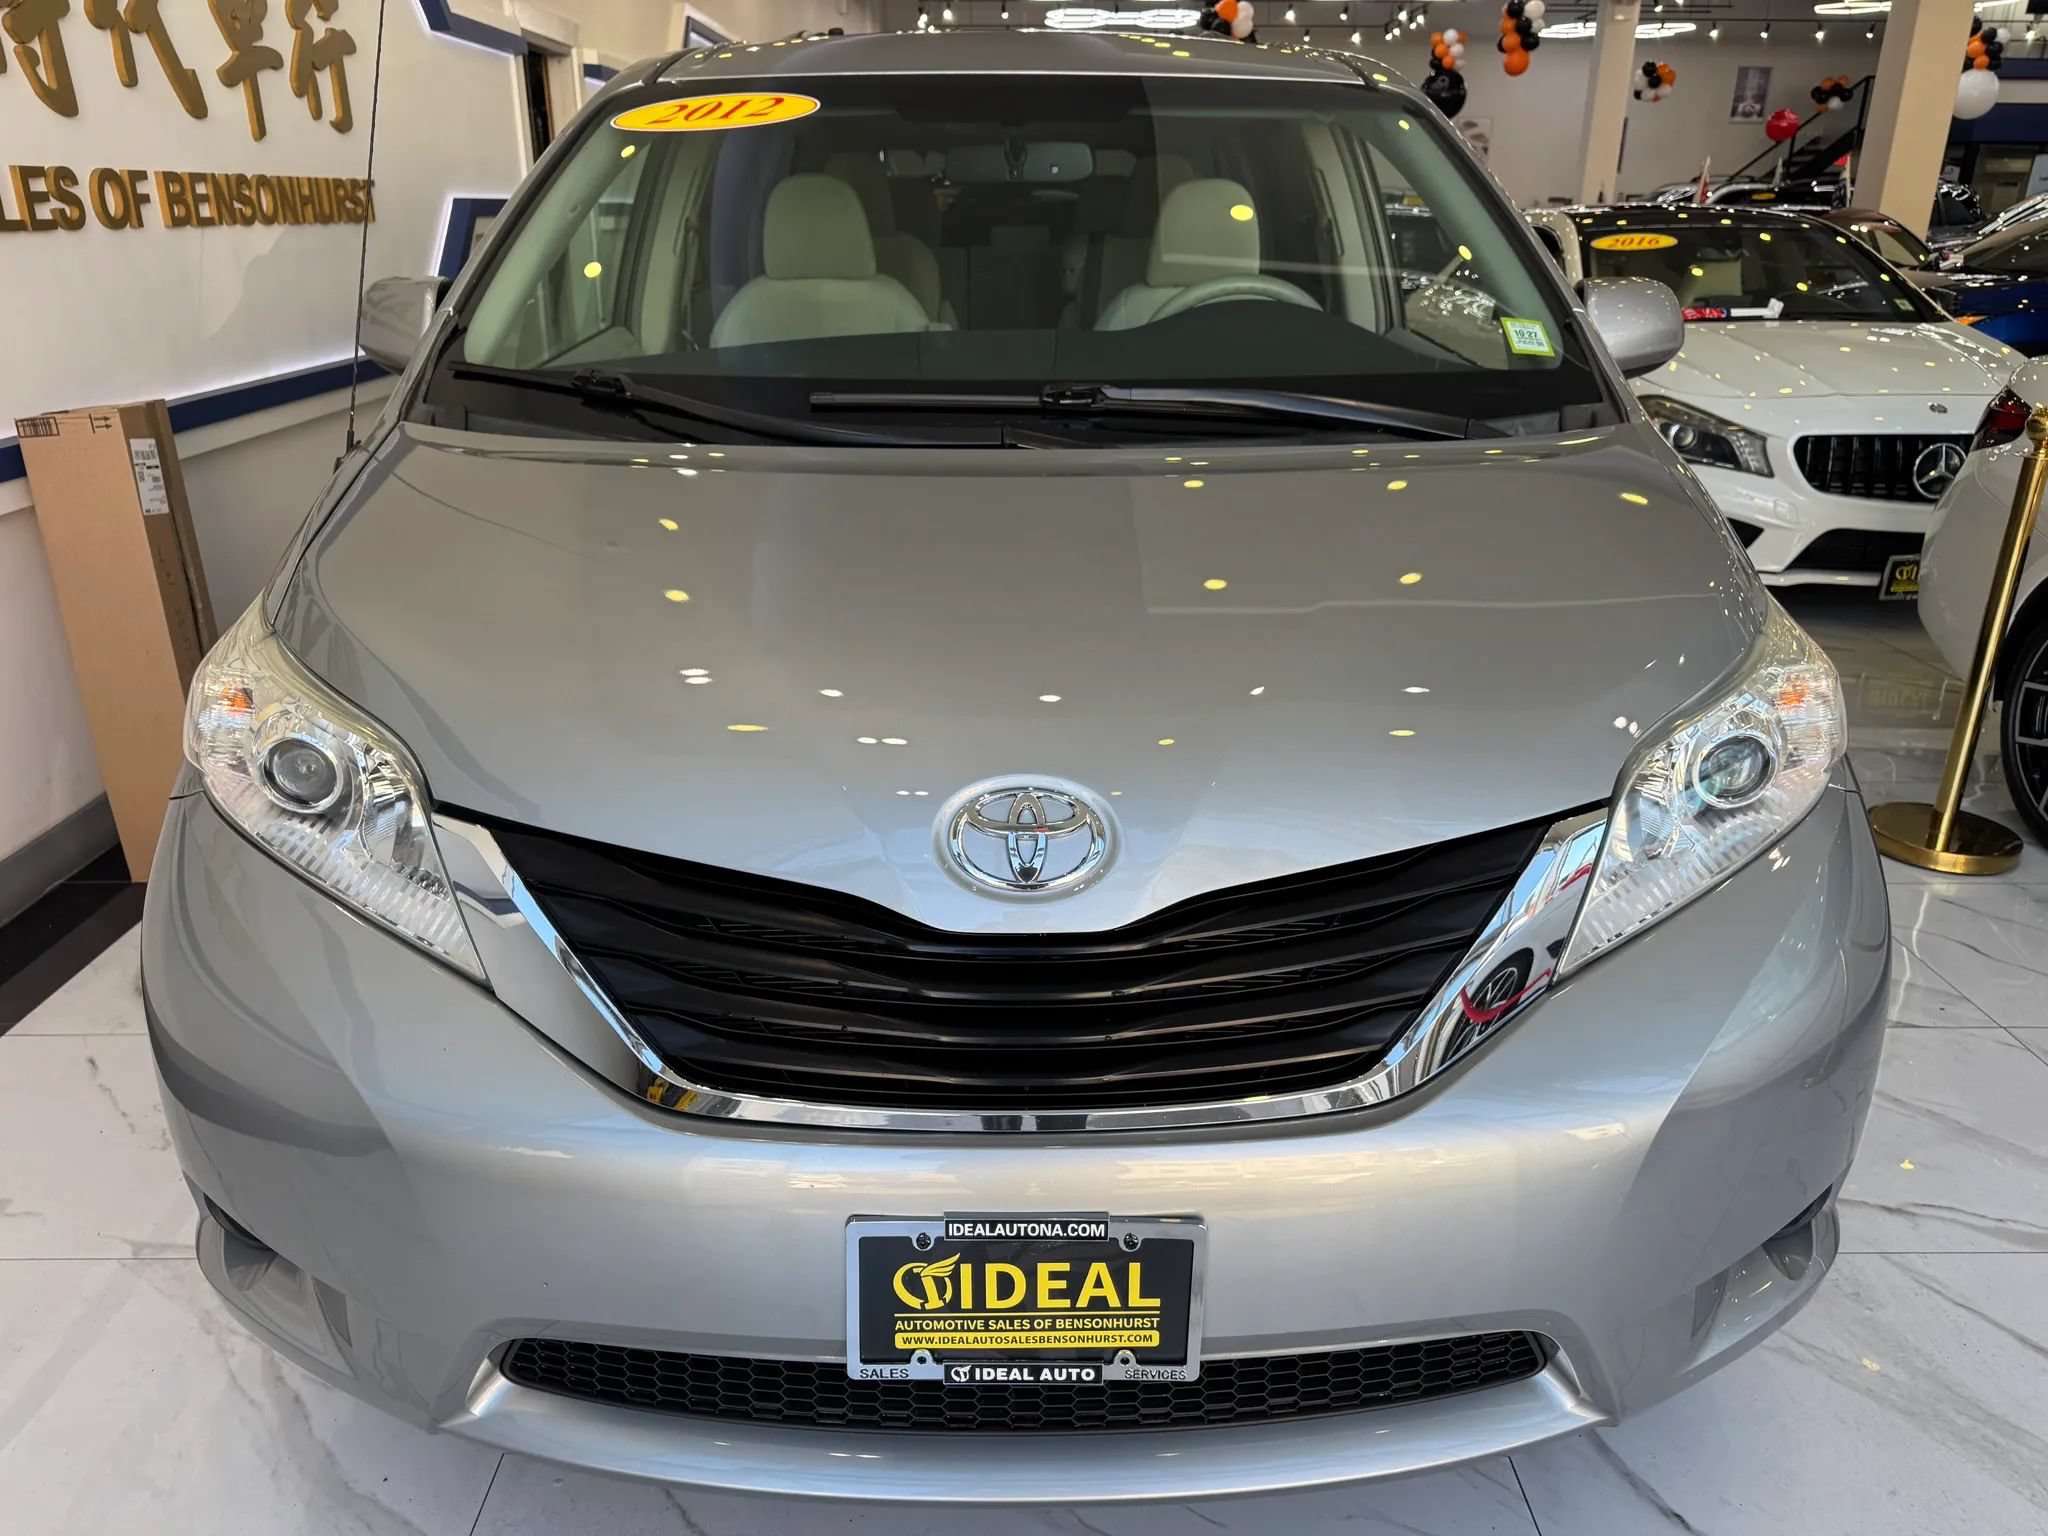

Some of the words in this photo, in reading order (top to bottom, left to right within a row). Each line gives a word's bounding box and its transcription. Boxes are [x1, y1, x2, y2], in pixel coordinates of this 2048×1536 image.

[646, 97, 785, 125] 2012
[88, 167, 151, 229] OF
[154, 170, 376, 228] BENSONHURST
[1608, 237, 1660, 248] 2016
[947, 1222, 1106, 1239] IDEALAUTONA.COM
[959, 1261, 1161, 1310] IDEAL
[894, 1319, 985, 1331] AUTOMOTIVE
[988, 1318, 1031, 1330] SALES
[1033, 1318, 1053, 1330] OF
[1055, 1317, 1161, 1329] BENSONHURST
[901, 1333, 1153, 1346] WWW.IDEALAUTOSALESBENSONHURST.COM
[859, 1367, 909, 1379] SALES
[975, 1368, 1034, 1381] IDEAL
[1039, 1368, 1096, 1381] AUTO
[1124, 1368, 1187, 1380] SERVICES
